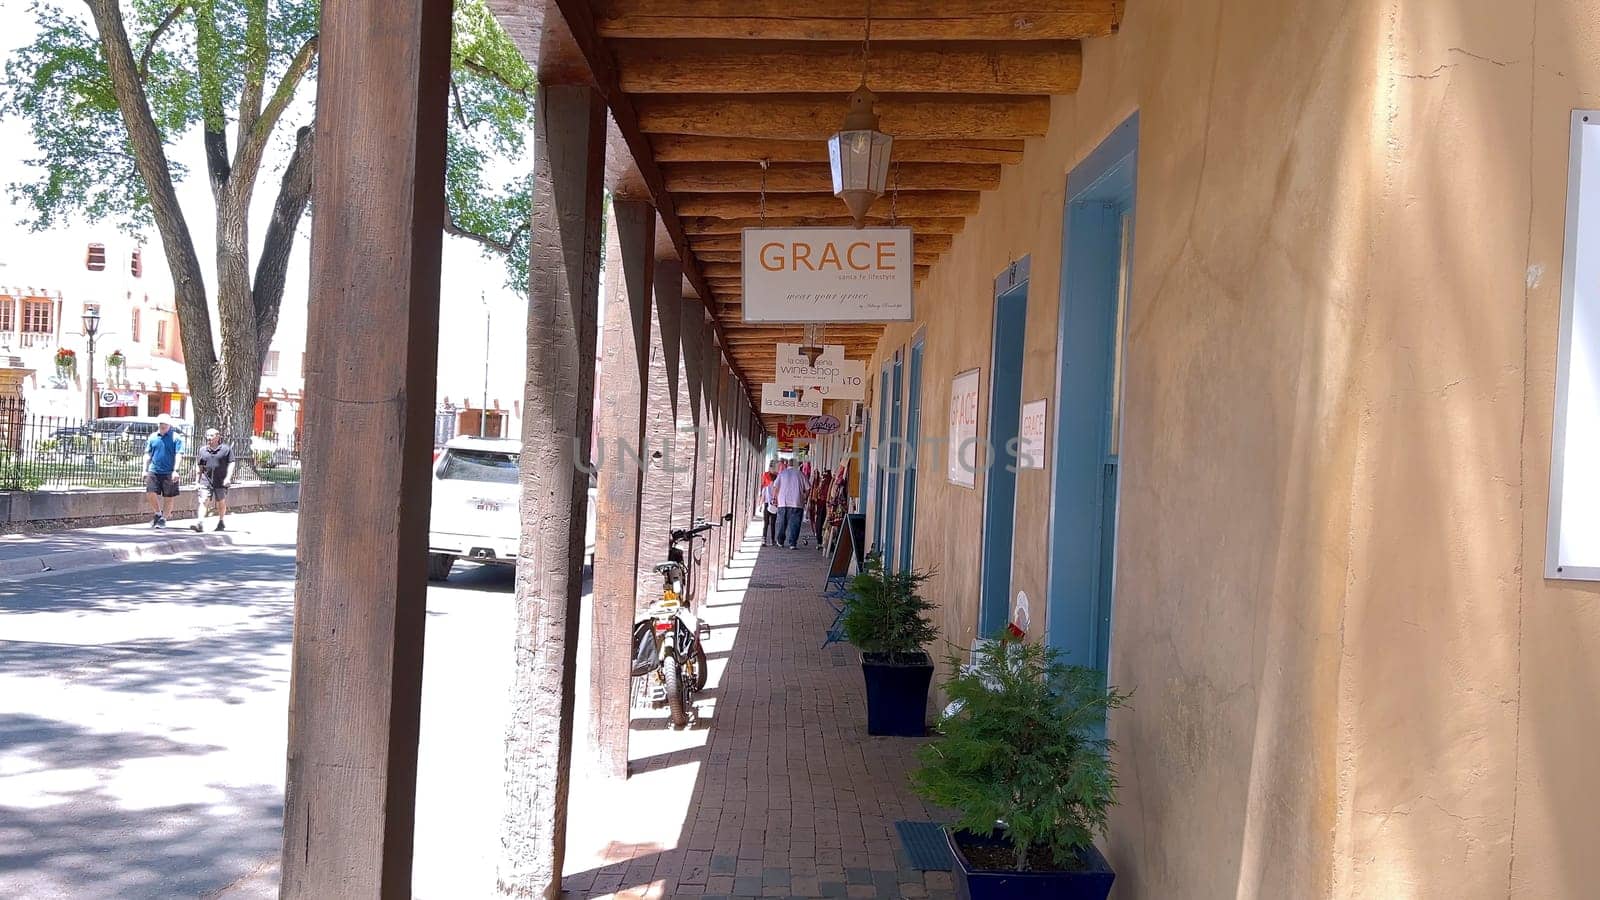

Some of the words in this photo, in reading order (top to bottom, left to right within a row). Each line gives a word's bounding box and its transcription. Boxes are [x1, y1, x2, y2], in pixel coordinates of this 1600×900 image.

[759, 242, 896, 271] GRACE
[814, 293, 837, 304] your
[780, 365, 809, 375] wine
[809, 365, 840, 383] shop
